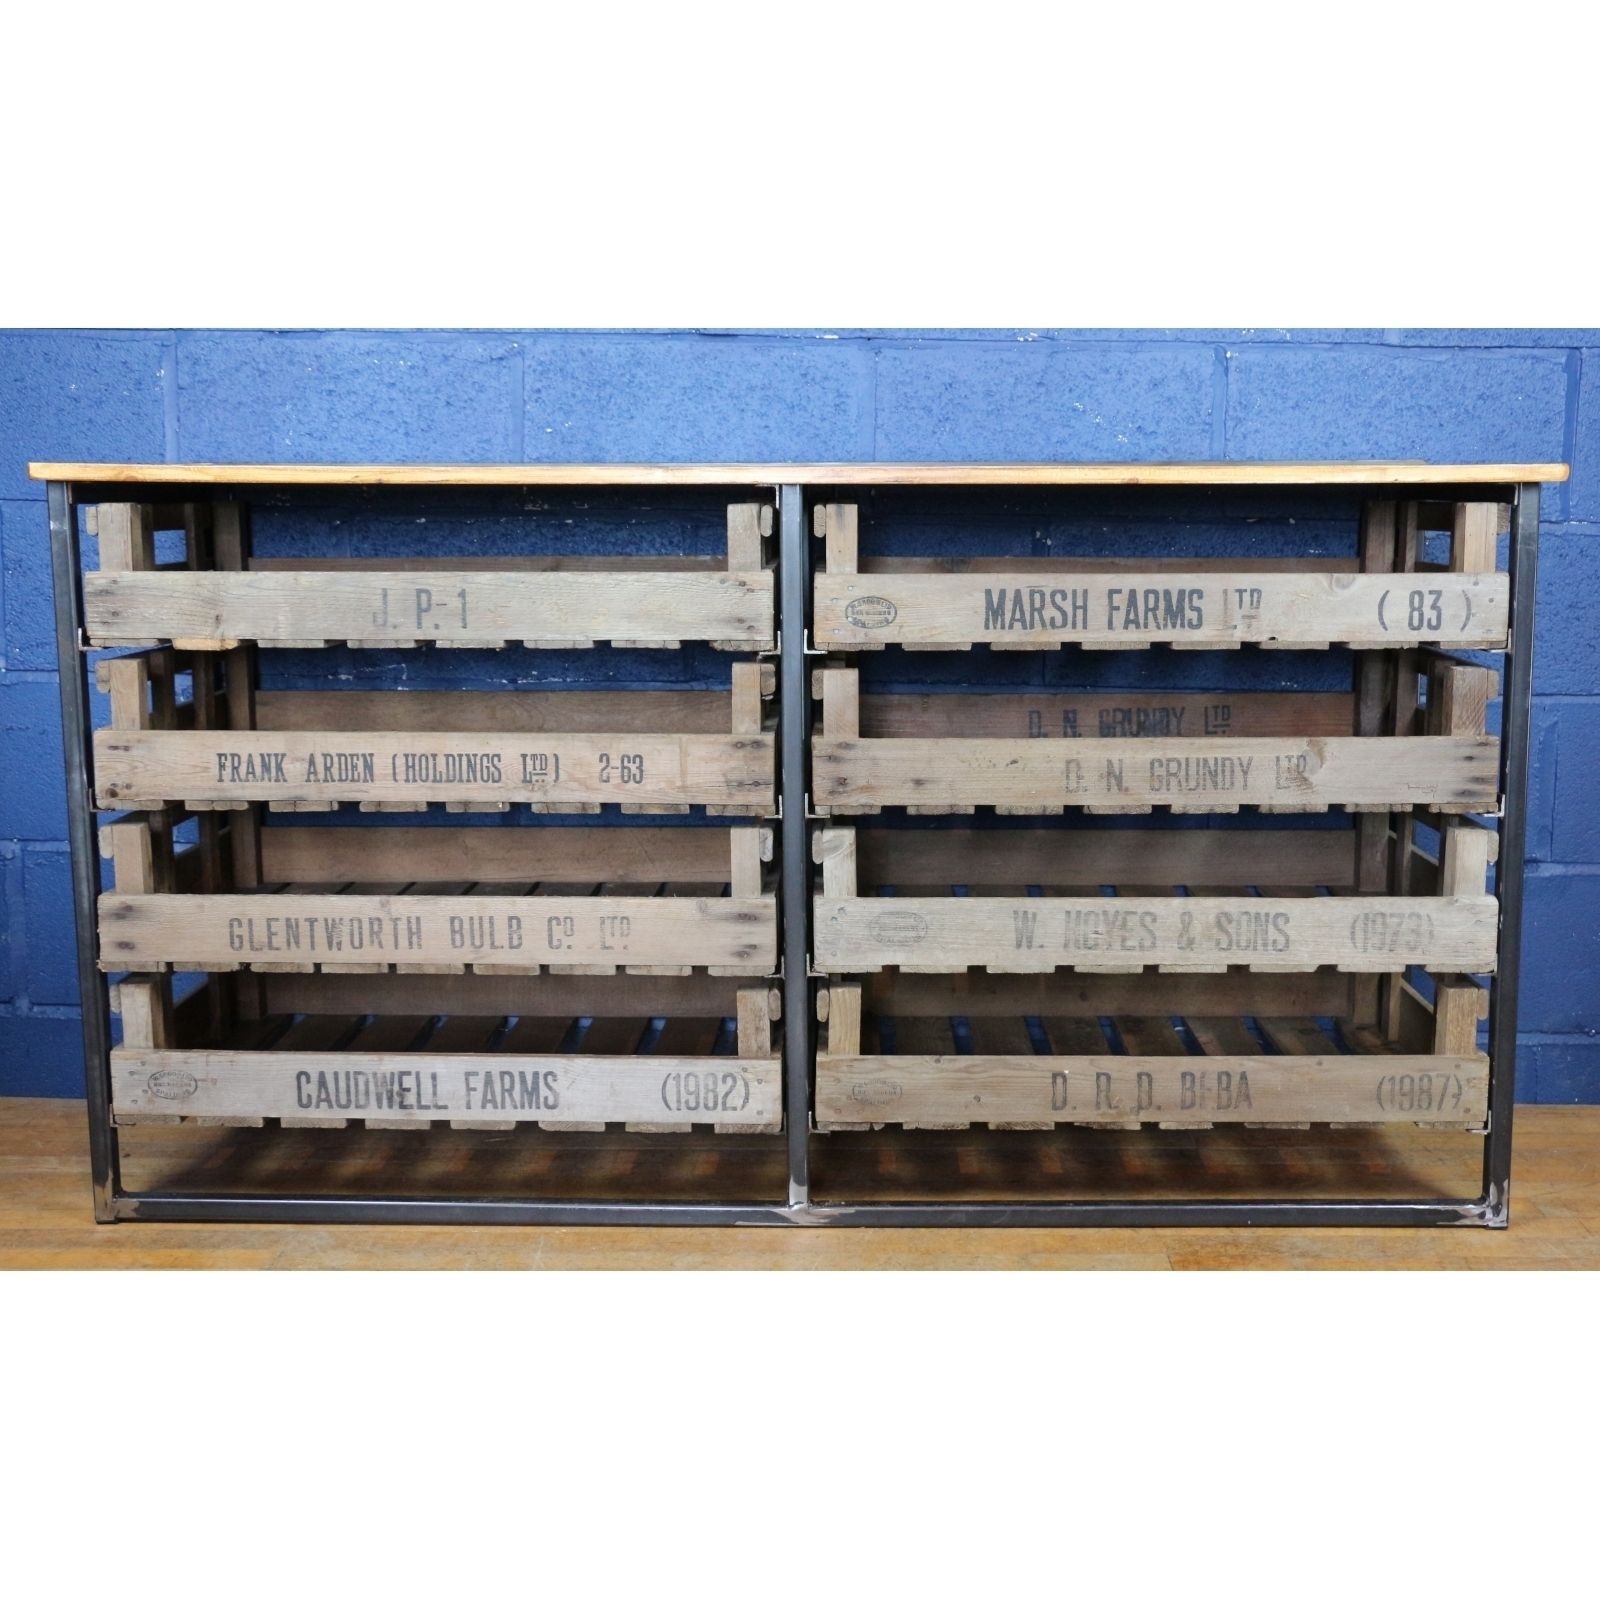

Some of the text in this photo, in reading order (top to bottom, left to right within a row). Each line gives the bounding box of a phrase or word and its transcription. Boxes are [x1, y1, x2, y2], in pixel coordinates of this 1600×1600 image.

[984, 588, 1088, 631] MARSH
[1107, 588, 1204, 631] FARMS
[1098, 706, 1186, 737] GRUNDY
[216, 752, 288, 783] FRANK
[305, 752, 375, 783] ARDEN
[391, 752, 502, 784] (HOLDINGS
[598, 752, 644, 784] 2-63
[1149, 755, 1253, 792] GRUNDY
[228, 916, 423, 952] GLENTWORTH
[449, 915, 524, 950] BULB
[1176, 911, 1196, 951] &
[1215, 911, 1291, 952] SONS
[295, 1070, 750, 1111] CAUDWELL FARMS (1982)
[1376, 1073, 1463, 1112] (1987)
